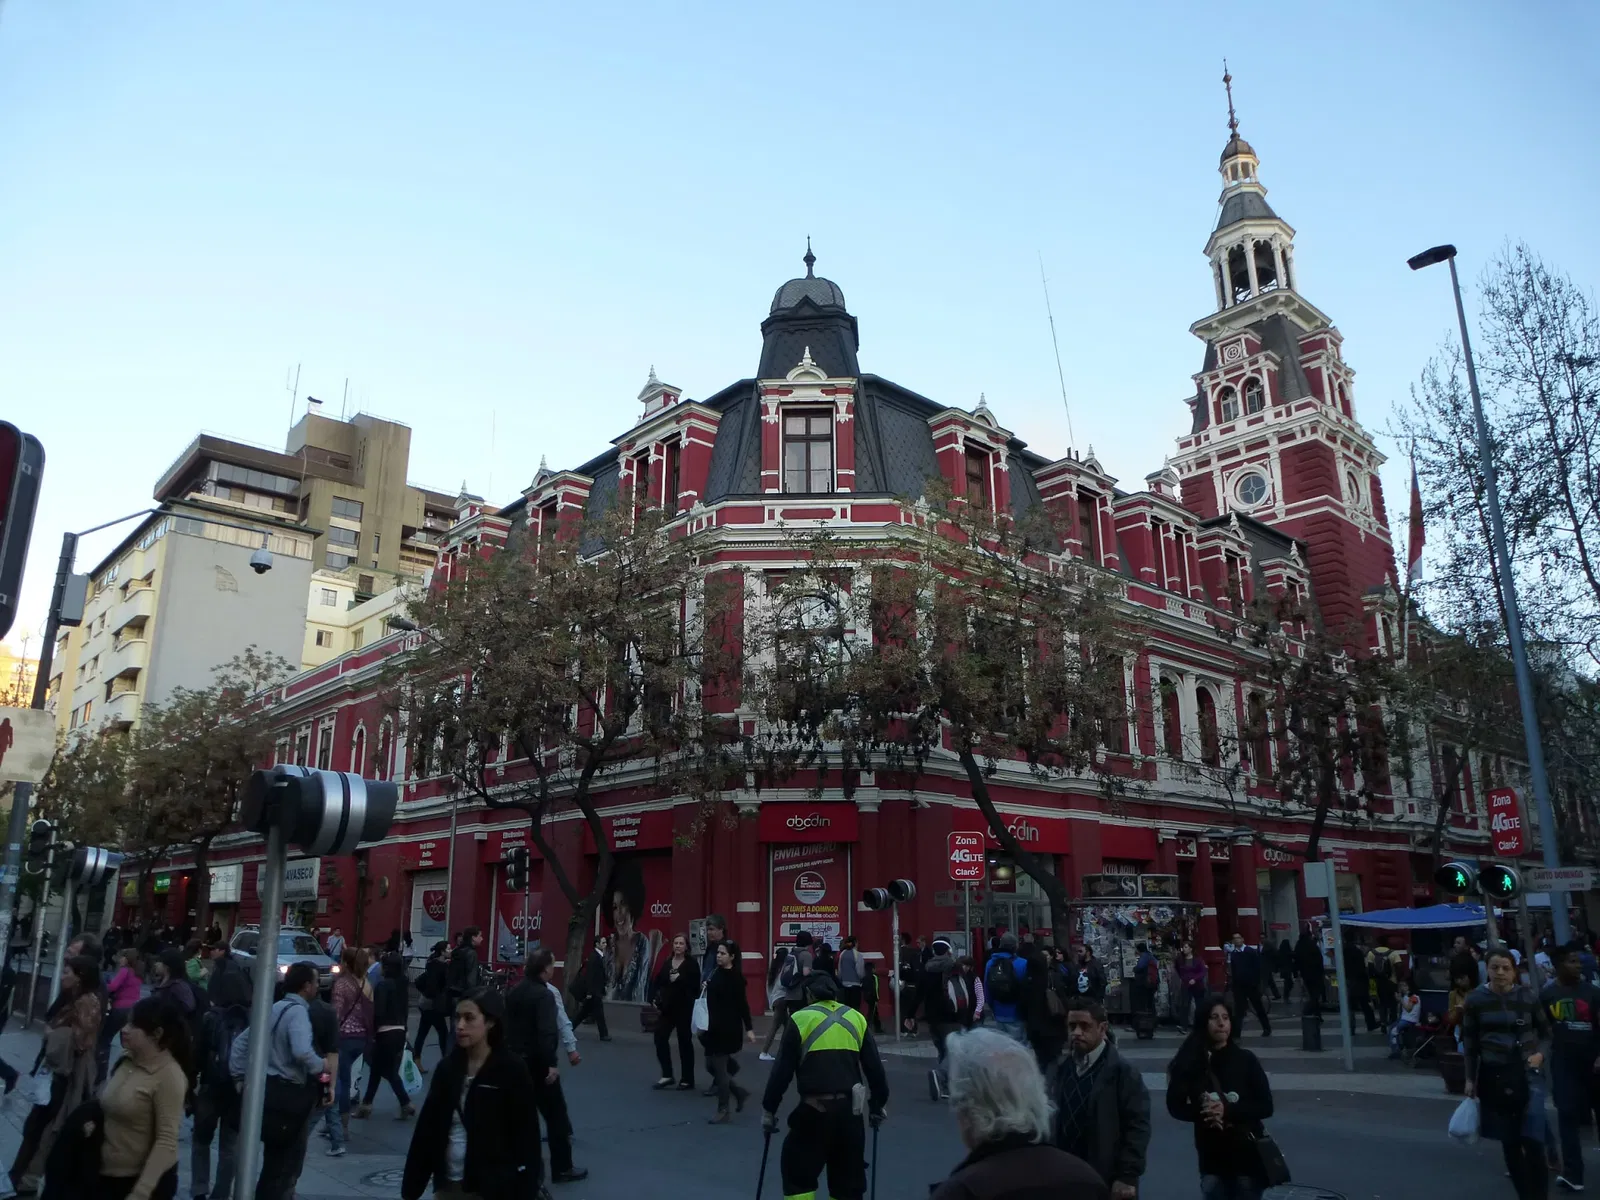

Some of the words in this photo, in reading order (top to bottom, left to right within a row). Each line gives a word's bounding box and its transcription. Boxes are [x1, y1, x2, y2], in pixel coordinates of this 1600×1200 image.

[1492, 795, 1511, 807] Zona
[786, 813, 831, 829] abcdin
[955, 836, 977, 845] Zona
[1498, 839, 1515, 850] Claro
[286, 867, 314, 880] AVASECO
[955, 868, 976, 876] Claro
